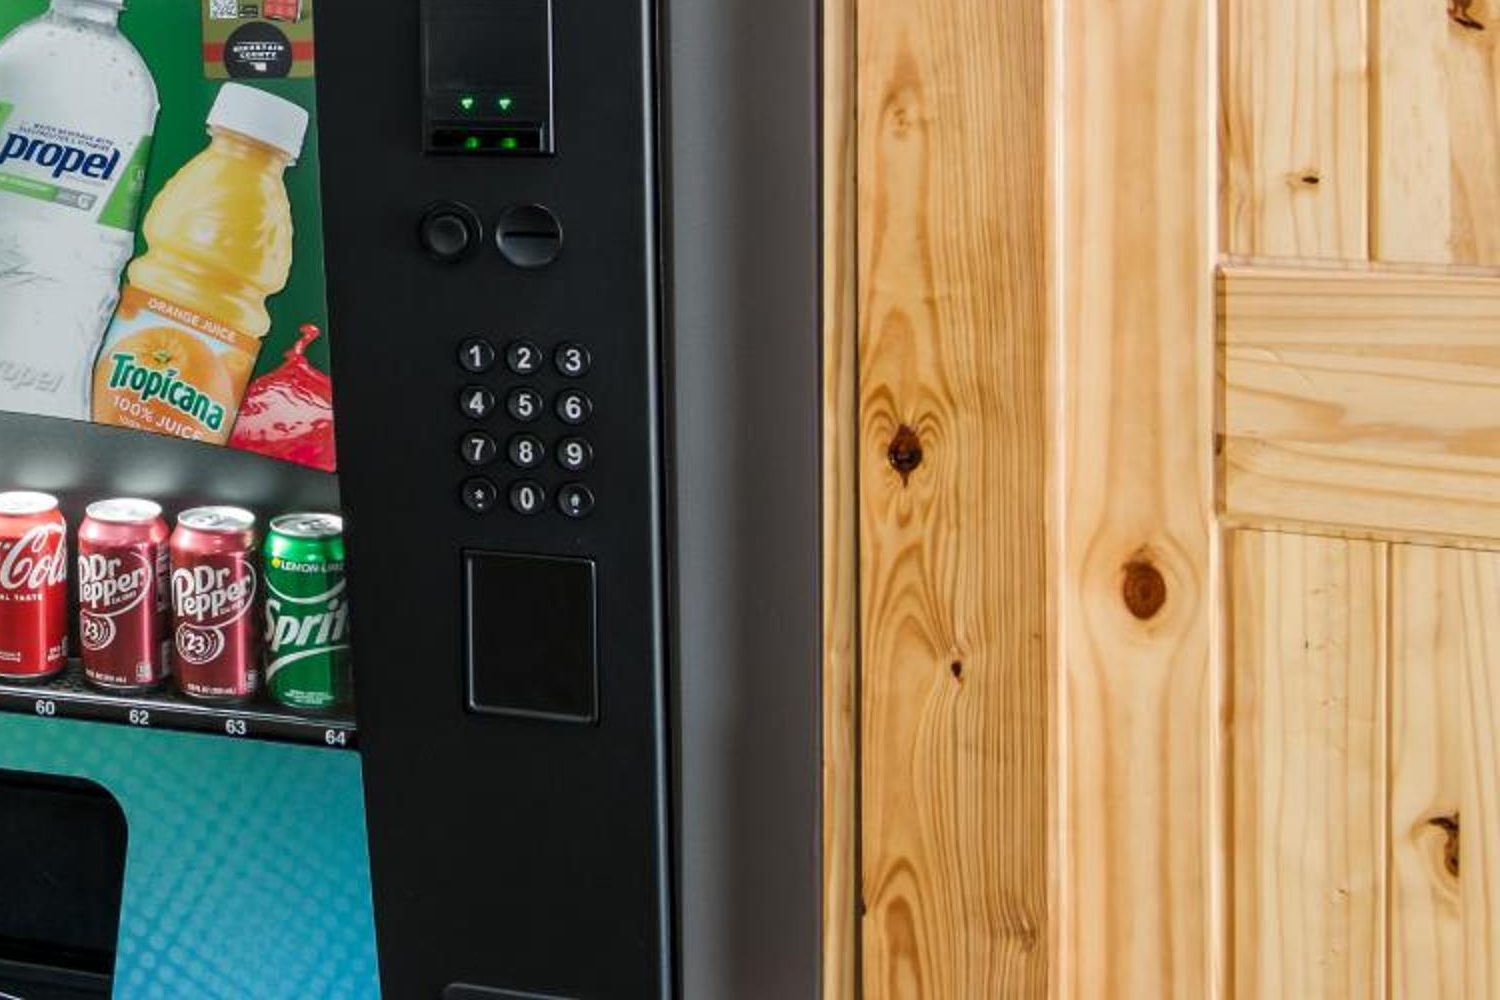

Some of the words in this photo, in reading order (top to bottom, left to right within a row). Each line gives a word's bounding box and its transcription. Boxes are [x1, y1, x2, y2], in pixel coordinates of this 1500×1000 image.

[148, 297, 200, 327] ORANGE
[200, 321, 237, 343] JUICE
[469, 345, 481, 367] 1
[517, 347, 531, 369] 2
[565, 349, 581, 371] 3
[109, 351, 226, 431] Tropicana
[114, 395, 154, 423] 100%
[469, 392, 484, 414] 4
[519, 394, 533, 416] 5
[565, 396, 581, 419] 6
[471, 439, 485, 461] 7
[519, 441, 533, 463] 8
[567, 443, 583, 465] 9
[520, 488, 534, 510] 0
[92, 553, 122, 583] Dr
[194, 565, 231, 593] Dr
[174, 568, 251, 621] Pepper
[186, 633, 205, 653] 23
[36, 701, 55, 715] 60
[129, 710, 149, 725] 62
[226, 719, 246, 735] 63
[325, 730, 346, 745] 64
